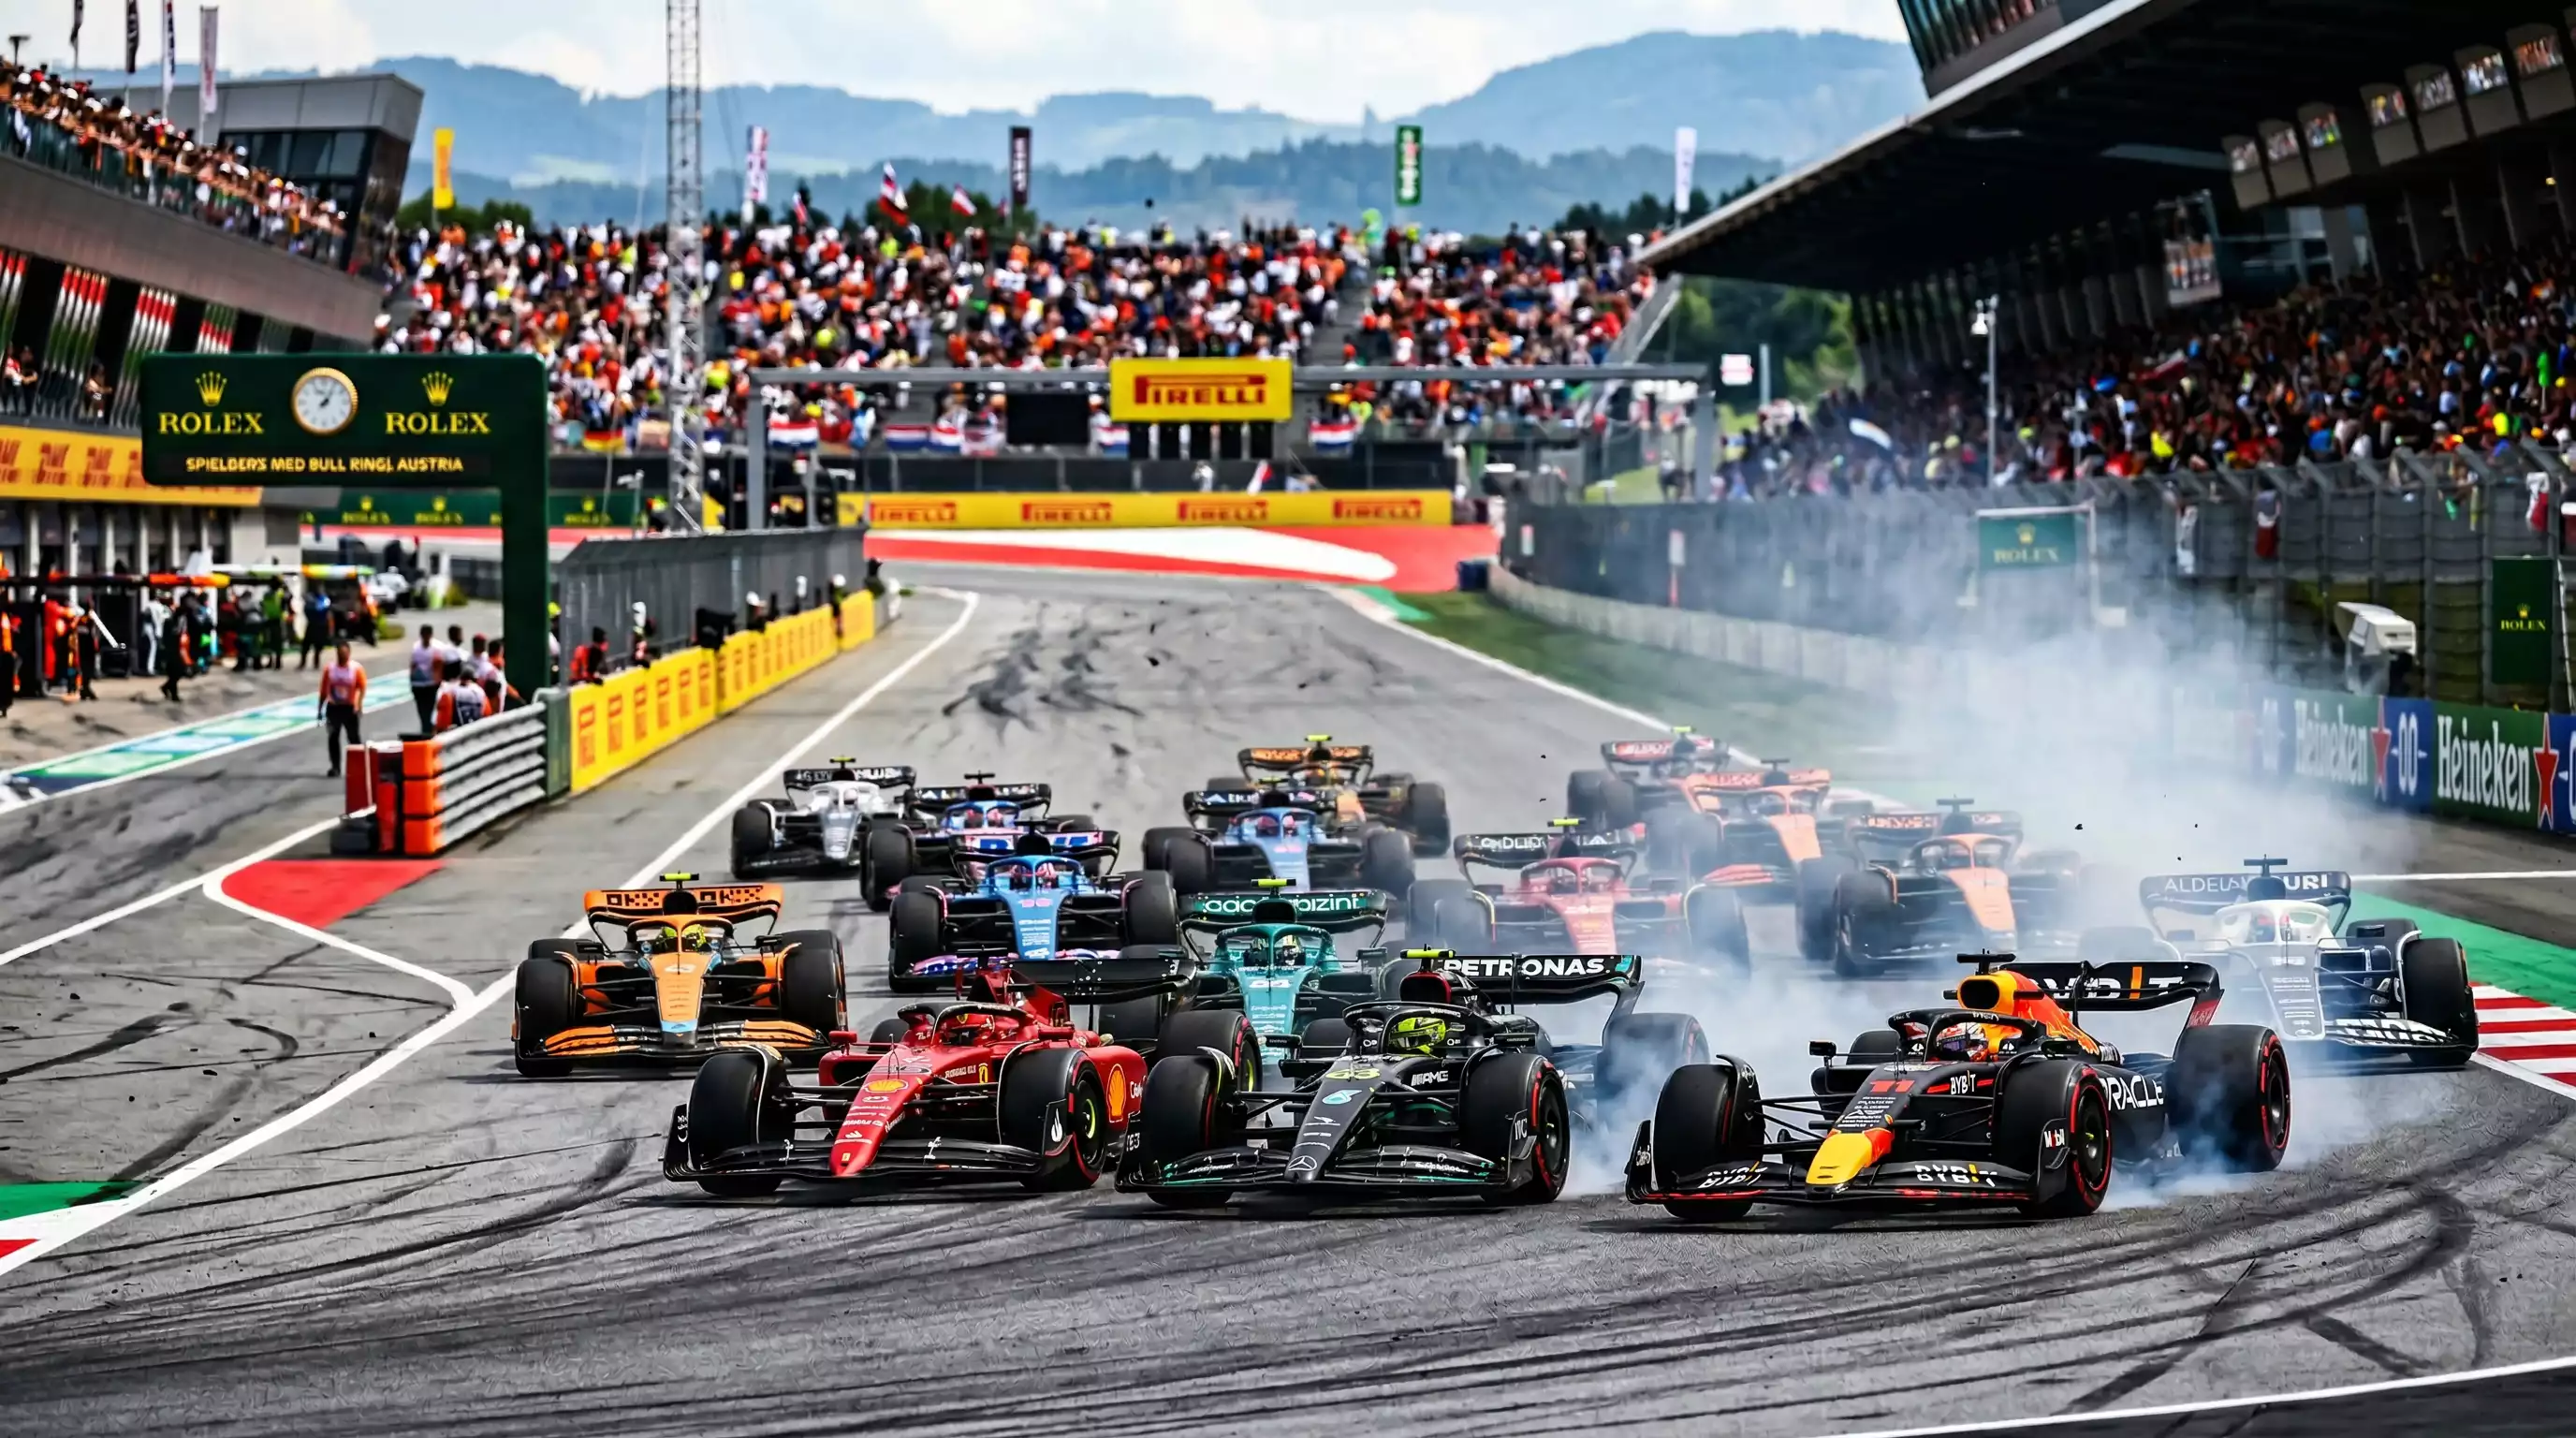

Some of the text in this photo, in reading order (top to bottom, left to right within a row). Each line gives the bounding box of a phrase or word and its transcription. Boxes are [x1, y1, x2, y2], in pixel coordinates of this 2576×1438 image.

[1134, 375, 1267, 404] PIRELLI
[159, 412, 264, 434] ROLEX
[385, 412, 490, 434] ROLEX
[309, 457, 345, 472] BULL
[397, 457, 463, 472] AUSTRIA
[1994, 549, 2058, 564] ROLEX
[2499, 620, 2546, 631] ROLEX
[2294, 700, 2368, 785] Heineken
[2437, 715, 2531, 812] Heineken
[1443, 959, 1604, 976] PETRONAS
[1869, 1079, 1915, 1093] 11
